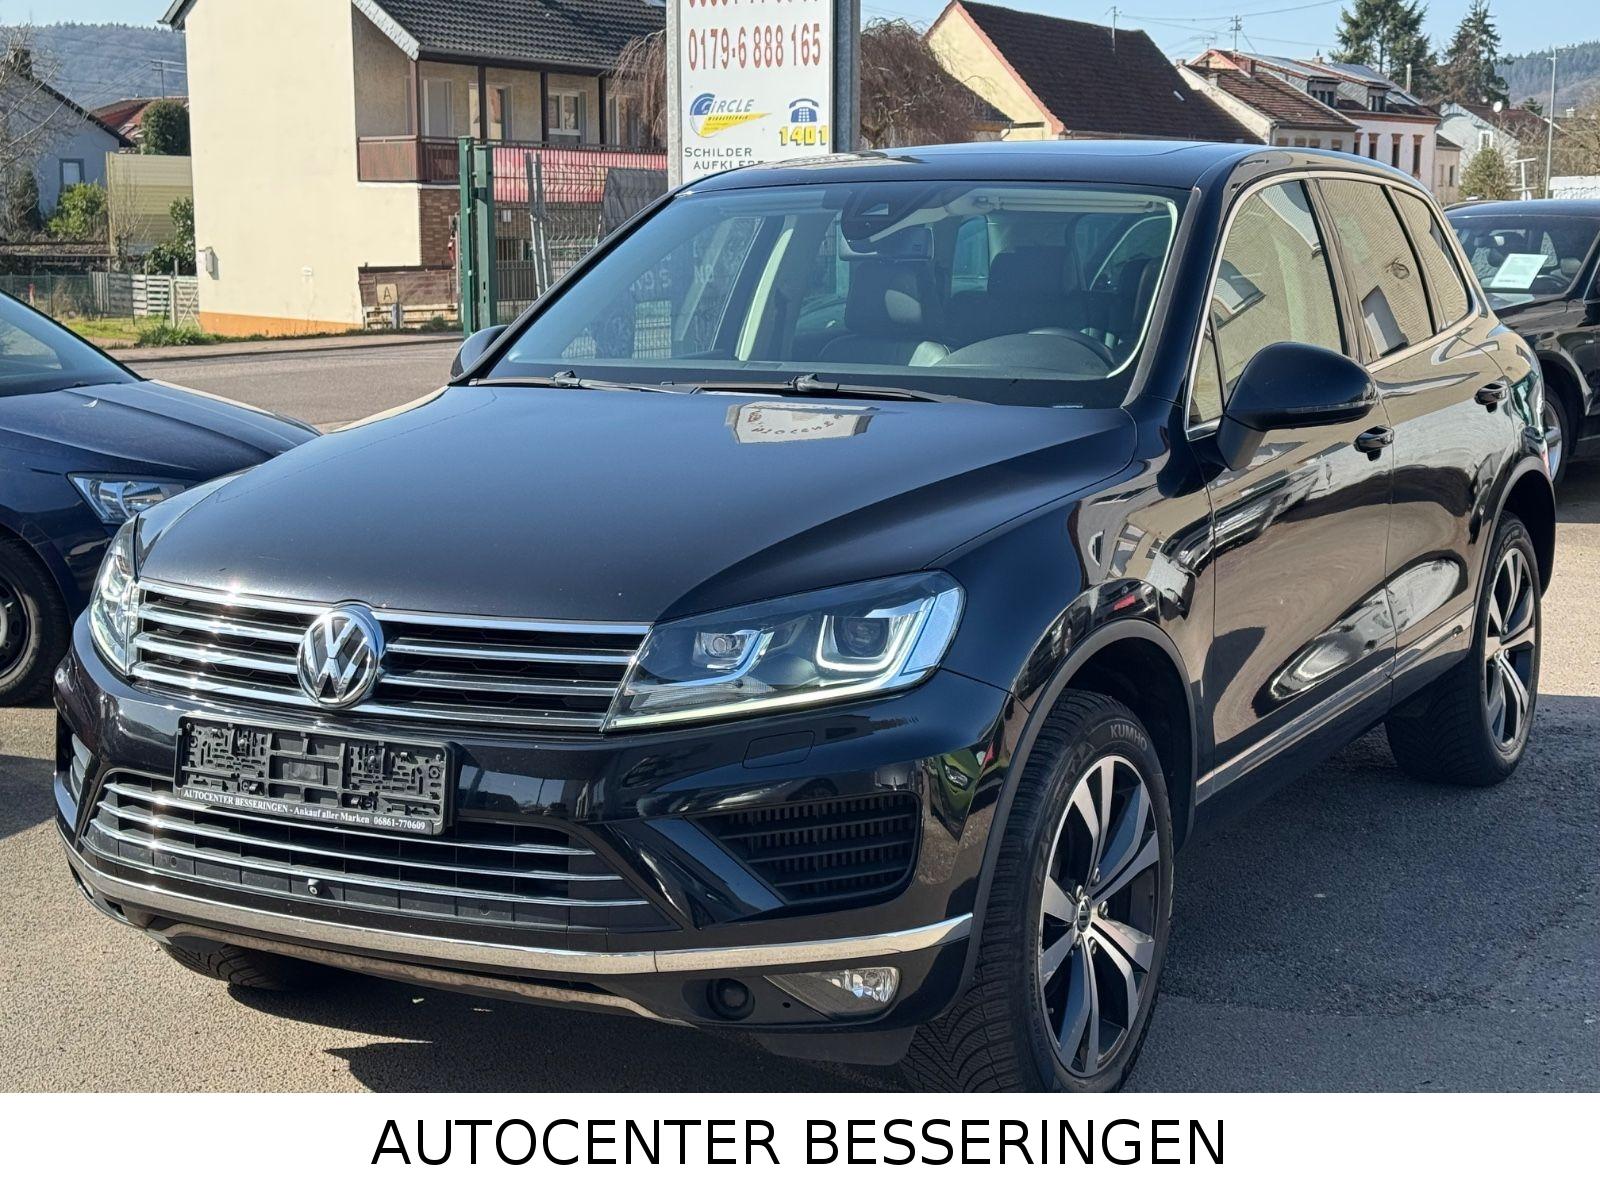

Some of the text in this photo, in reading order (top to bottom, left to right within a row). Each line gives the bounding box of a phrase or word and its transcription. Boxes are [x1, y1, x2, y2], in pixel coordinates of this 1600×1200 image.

[753, 24, 784, 69] 888
[791, 22, 821, 66] 165
[779, 125, 829, 146] 1401
[684, 146, 752, 158] SCHILDER
[383, 286, 392, 300] A
[1110, 724, 1147, 751] KUMHO
[183, 789, 234, 805] AUTOCENTER
[234, 796, 288, 813] BESSERINGEN
[293, 805, 321, 819] Ankauf
[321, 810, 339, 820] aller
[340, 812, 370, 824] Marken
[373, 816, 426, 830] 06861-770609
